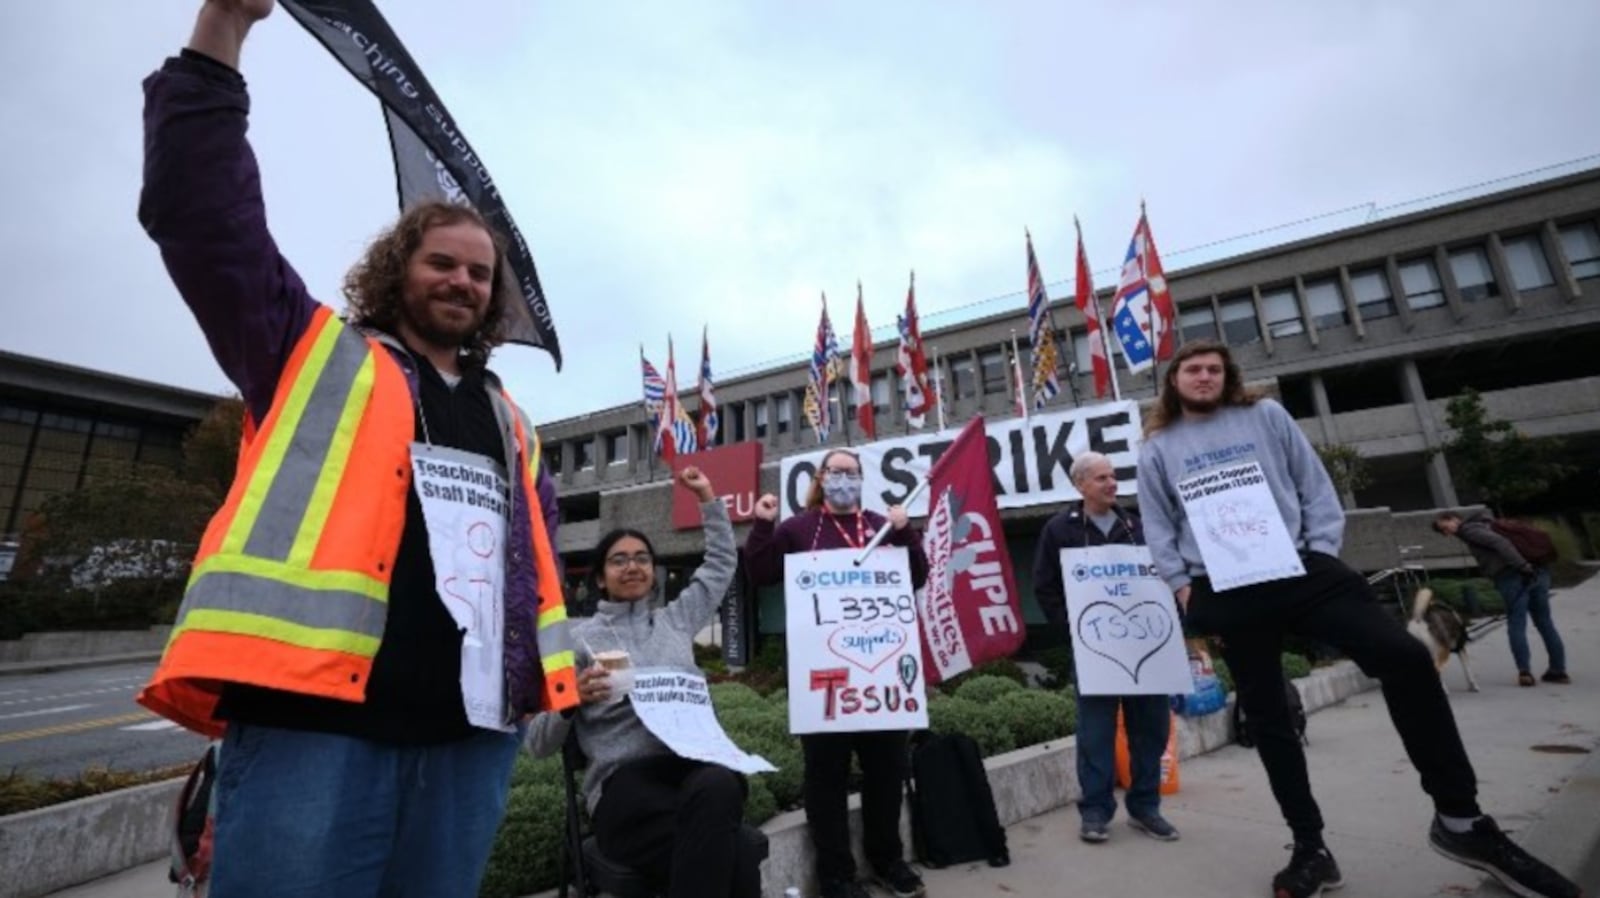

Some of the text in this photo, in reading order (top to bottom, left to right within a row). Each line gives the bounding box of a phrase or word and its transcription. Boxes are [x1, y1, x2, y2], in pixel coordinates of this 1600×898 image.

[323, 17, 419, 98] ching
[415, 458, 494, 491] Teaching
[786, 461, 816, 516] O
[421, 480, 464, 503] Staff
[721, 492, 754, 516] FU
[957, 511, 1018, 636] CUPE
[1104, 583, 1131, 596] WE
[728, 577, 738, 659] INFORMAT
[840, 595, 915, 624] 3338
[1087, 614, 1164, 641] TSSU
